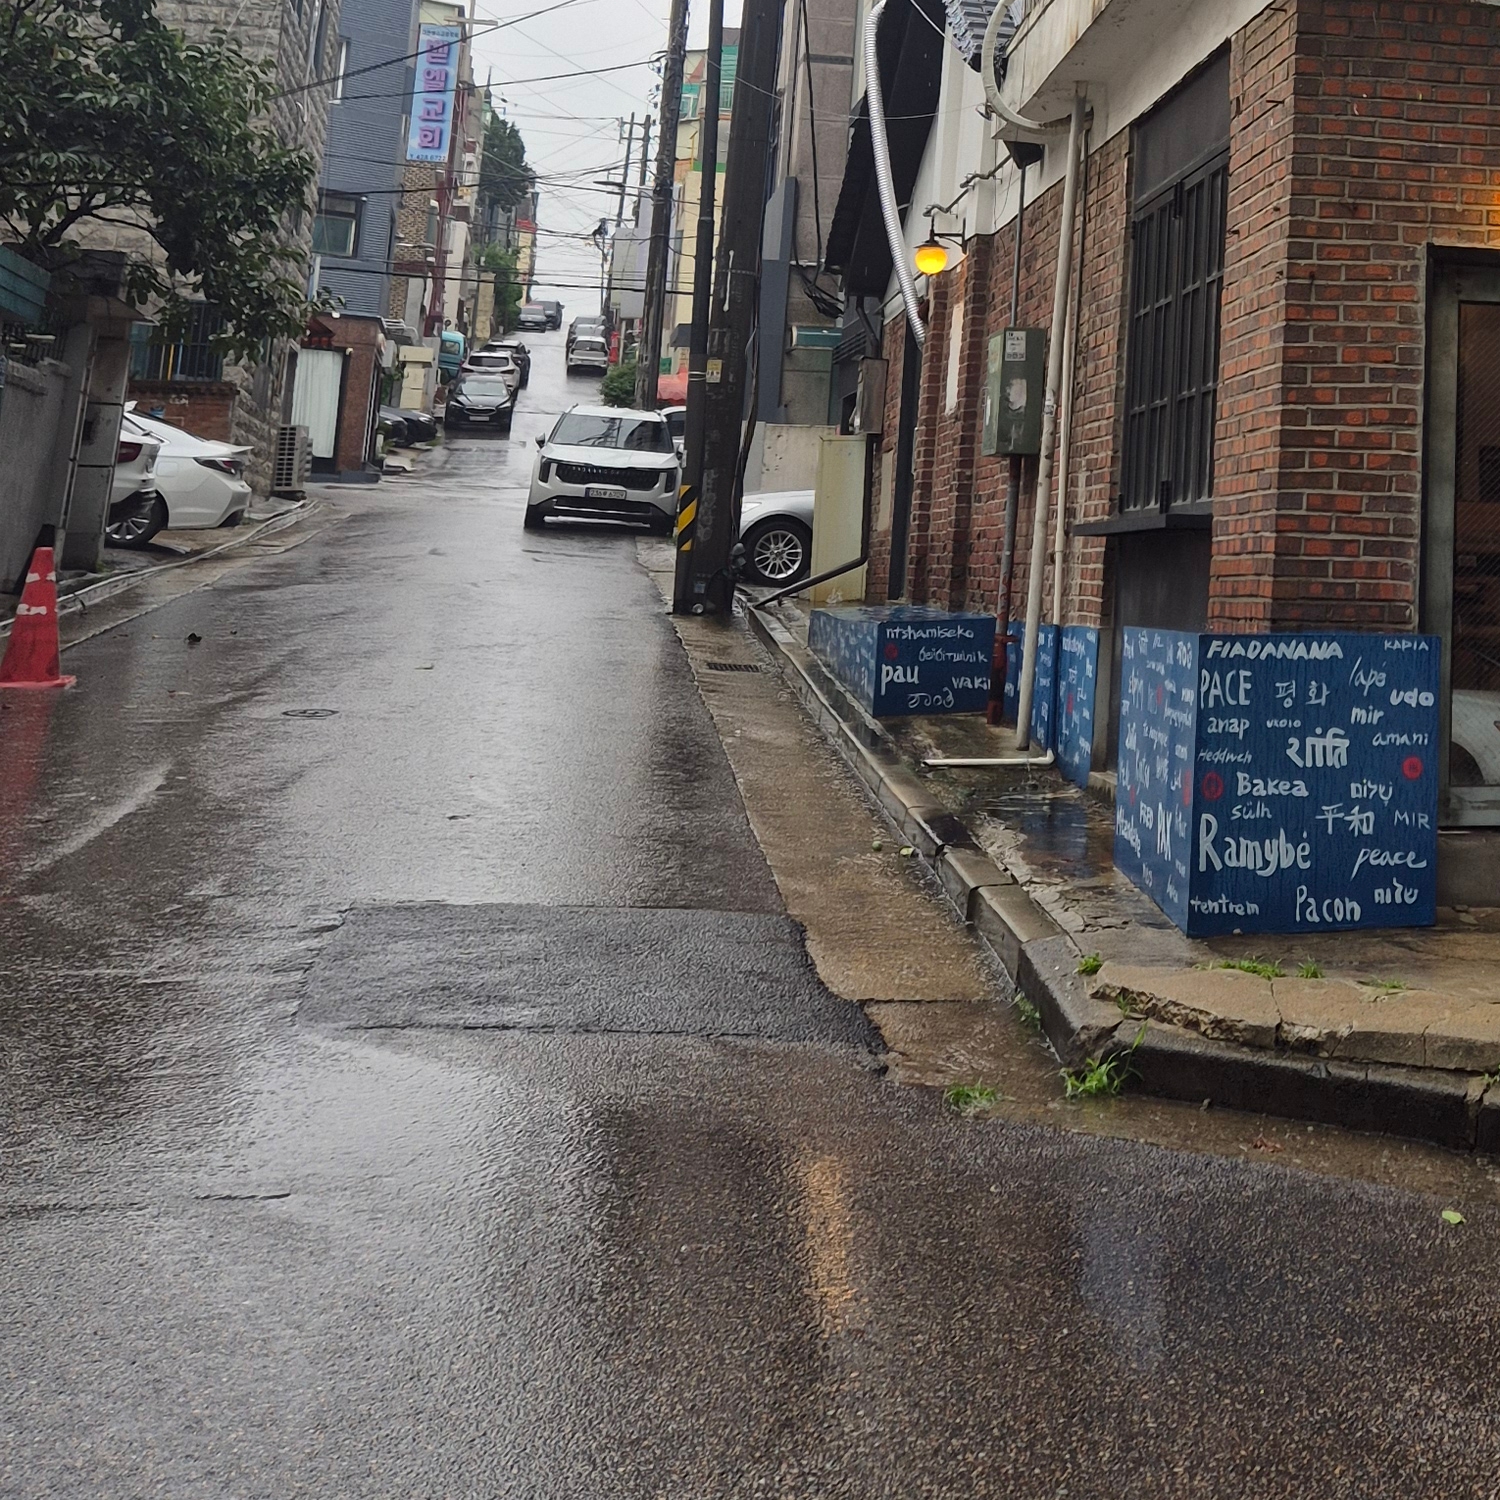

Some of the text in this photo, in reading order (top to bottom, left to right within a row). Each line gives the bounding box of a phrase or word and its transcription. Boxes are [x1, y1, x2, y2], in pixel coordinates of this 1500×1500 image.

[418, 39, 451, 150] 벧엘교회
[1207, 639, 1343, 660] FIADANANA
[880, 663, 919, 696] pau
[1200, 668, 1252, 710] PACE
[1390, 687, 1435, 708] udo
[1350, 705, 1385, 725] mir
[1372, 732, 1428, 746] amani
[1236, 771, 1309, 797] Bakea
[1231, 801, 1272, 821] sülh
[1315, 802, 1375, 837] 平和
[1393, 809, 1431, 830] MIR
[1157, 801, 1172, 861] PAX
[1199, 813, 1311, 877] Ramybė
[1350, 848, 1427, 881] peace
[1190, 893, 1260, 916] tentrem
